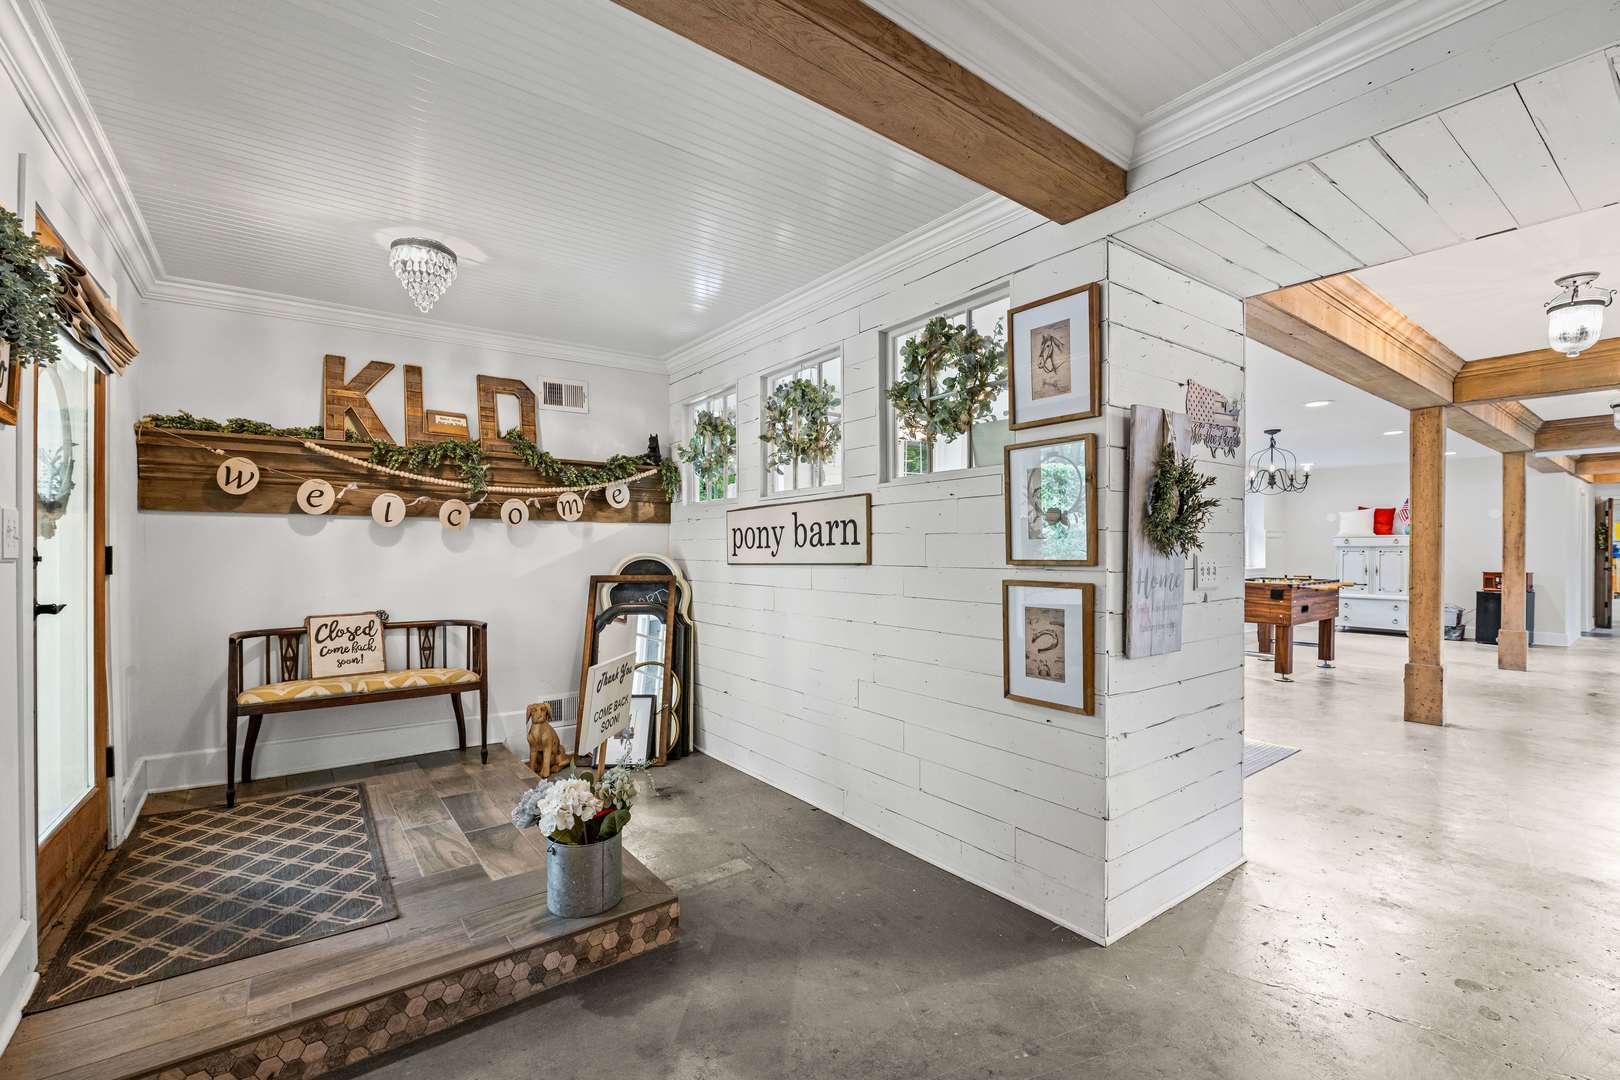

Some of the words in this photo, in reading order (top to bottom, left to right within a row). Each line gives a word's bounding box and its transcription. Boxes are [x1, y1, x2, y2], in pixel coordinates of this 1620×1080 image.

[323, 354, 537, 451] KLD
[732, 525, 785, 557] pony
[792, 512, 861, 548] barn
[315, 620, 378, 644] Closed
[597, 667, 619, 693] Thank
[619, 662, 633, 684] You
[594, 703, 613, 723] COME
[613, 695, 630, 712] BACK
[601, 711, 621, 733] SOON!
